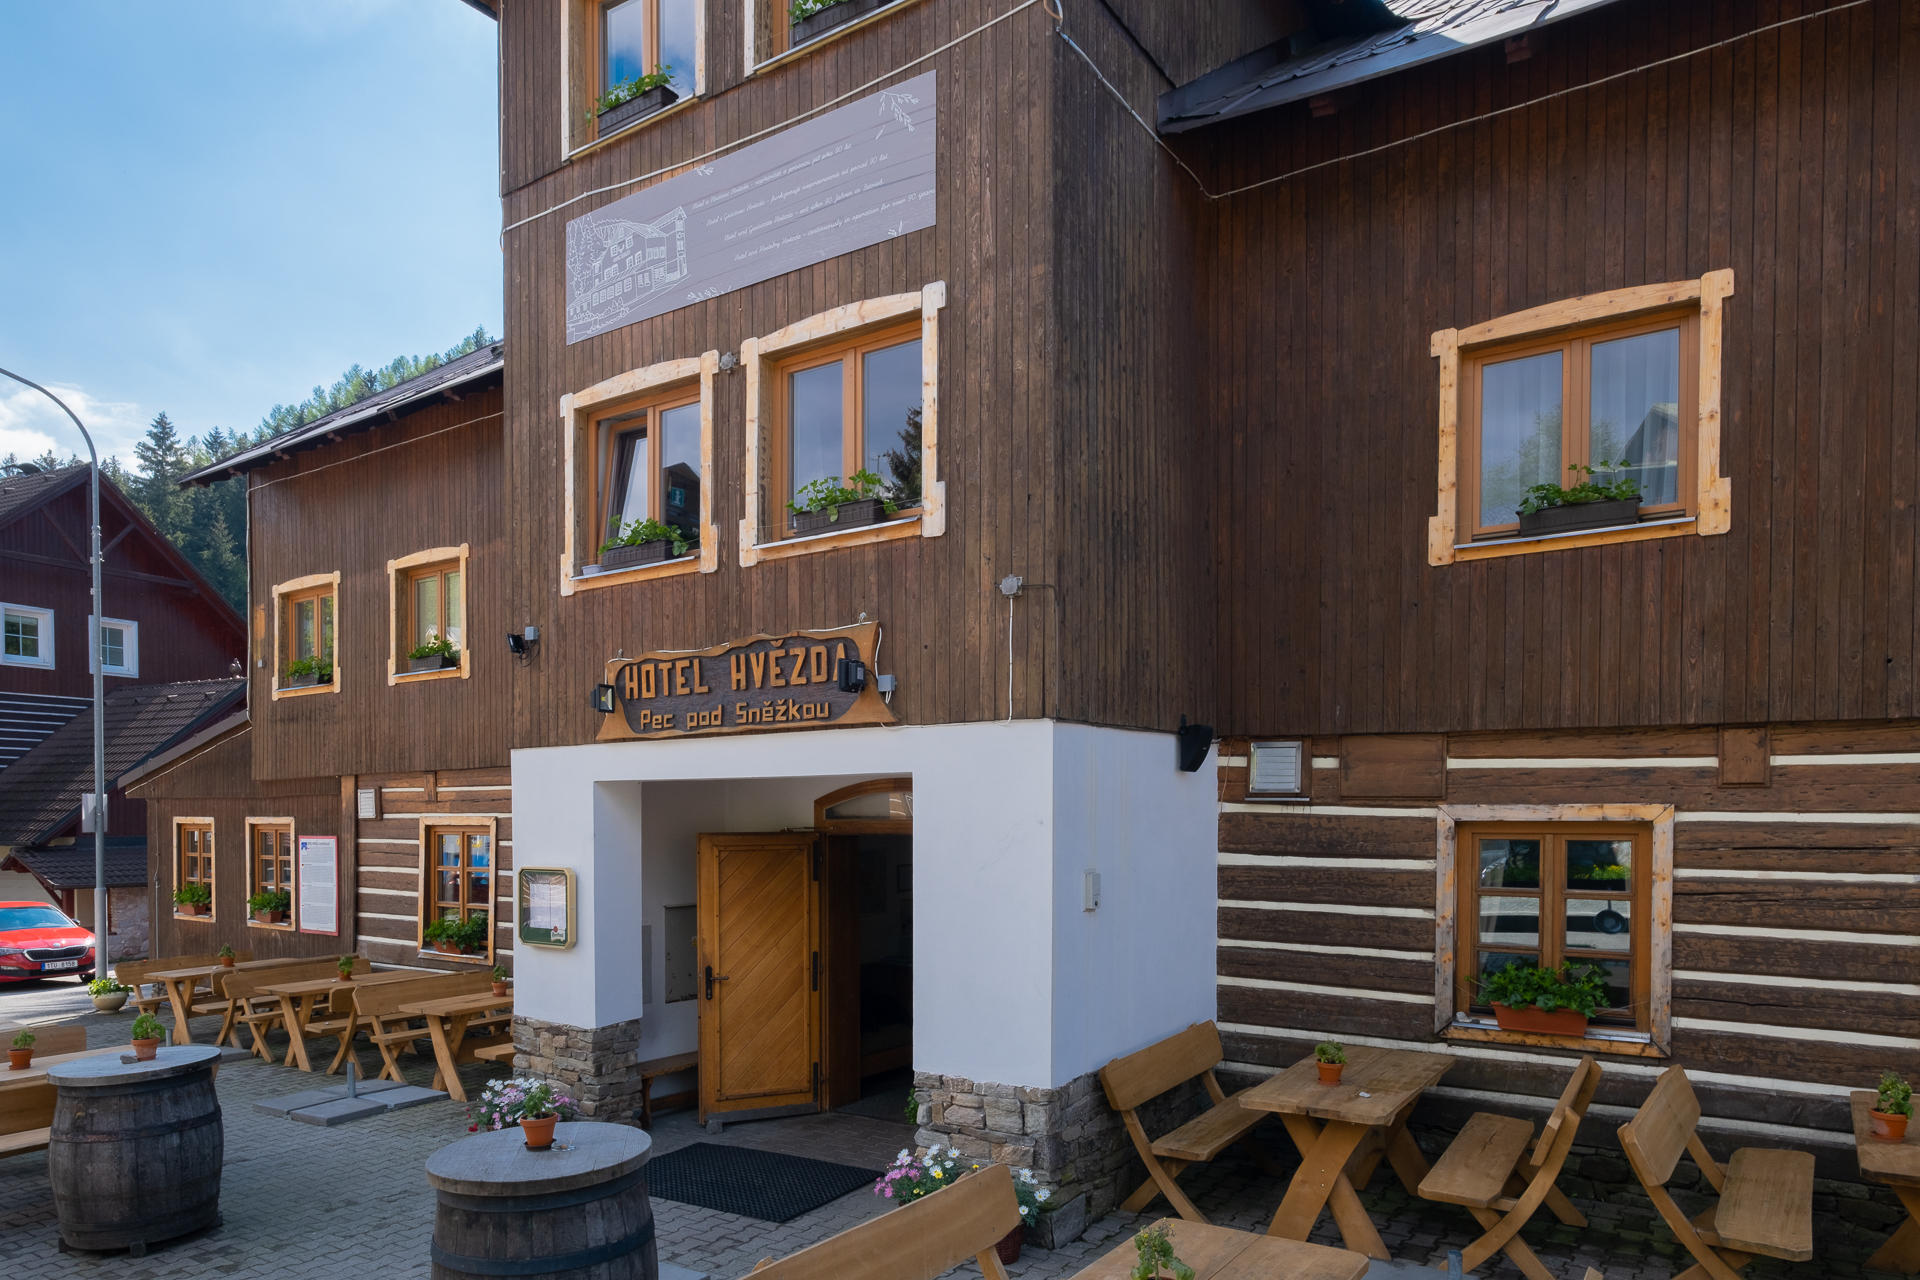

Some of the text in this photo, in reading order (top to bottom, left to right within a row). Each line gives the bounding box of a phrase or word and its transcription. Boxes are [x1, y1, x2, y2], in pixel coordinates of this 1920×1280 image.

[835, 145, 843, 154] 90
[869, 155, 878, 165] 90
[824, 196, 833, 206] 90
[852, 207, 880, 222] operation
[880, 202, 891, 213] for
[891, 198, 906, 207] over
[907, 192, 917, 202] 90
[625, 659, 709, 699] HOTEL
[640, 698, 830, 731] Pec pod Sněžkou
